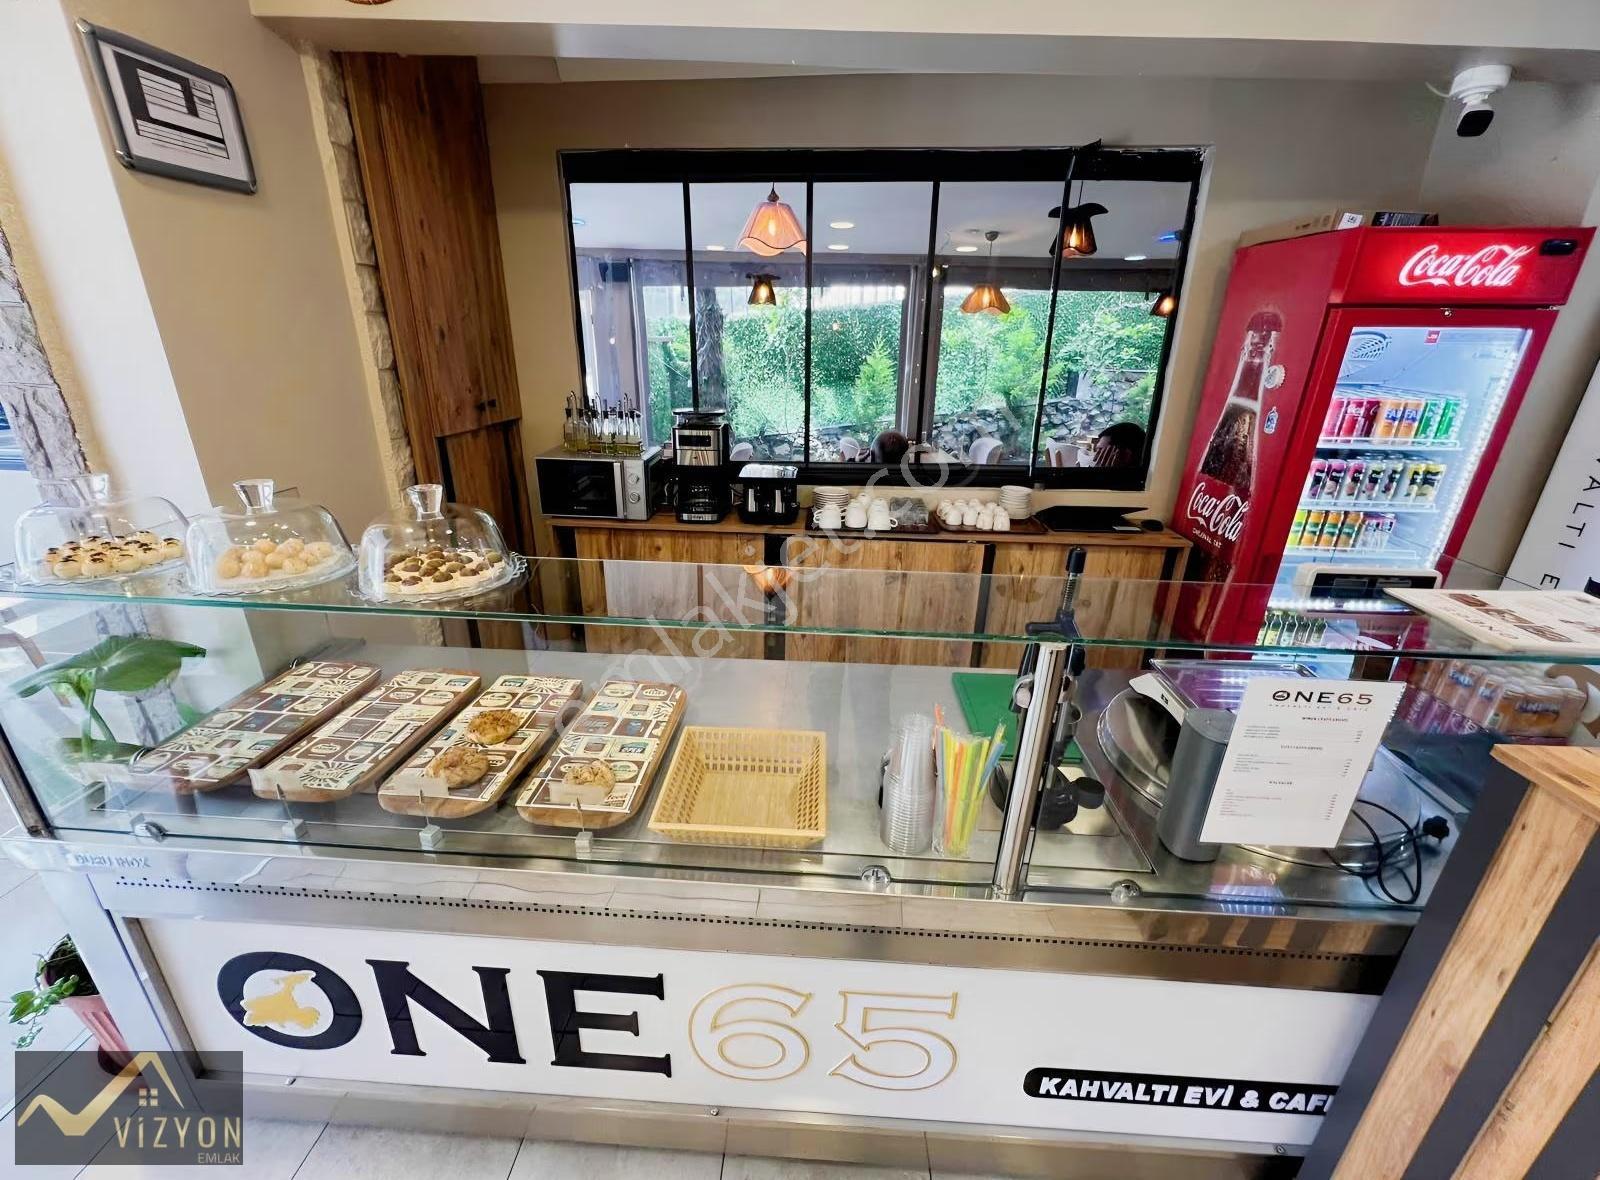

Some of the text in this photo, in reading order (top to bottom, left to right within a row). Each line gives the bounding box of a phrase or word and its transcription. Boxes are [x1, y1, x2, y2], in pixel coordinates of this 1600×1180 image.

[1398, 244, 1535, 287] Coca-Cola
[1187, 481, 1250, 542] Coca-Cola
[1039, 1076, 1179, 1103] KAHVALTI
[1183, 1084, 1235, 1107] EVİ
[1240, 1090, 1259, 1109] &
